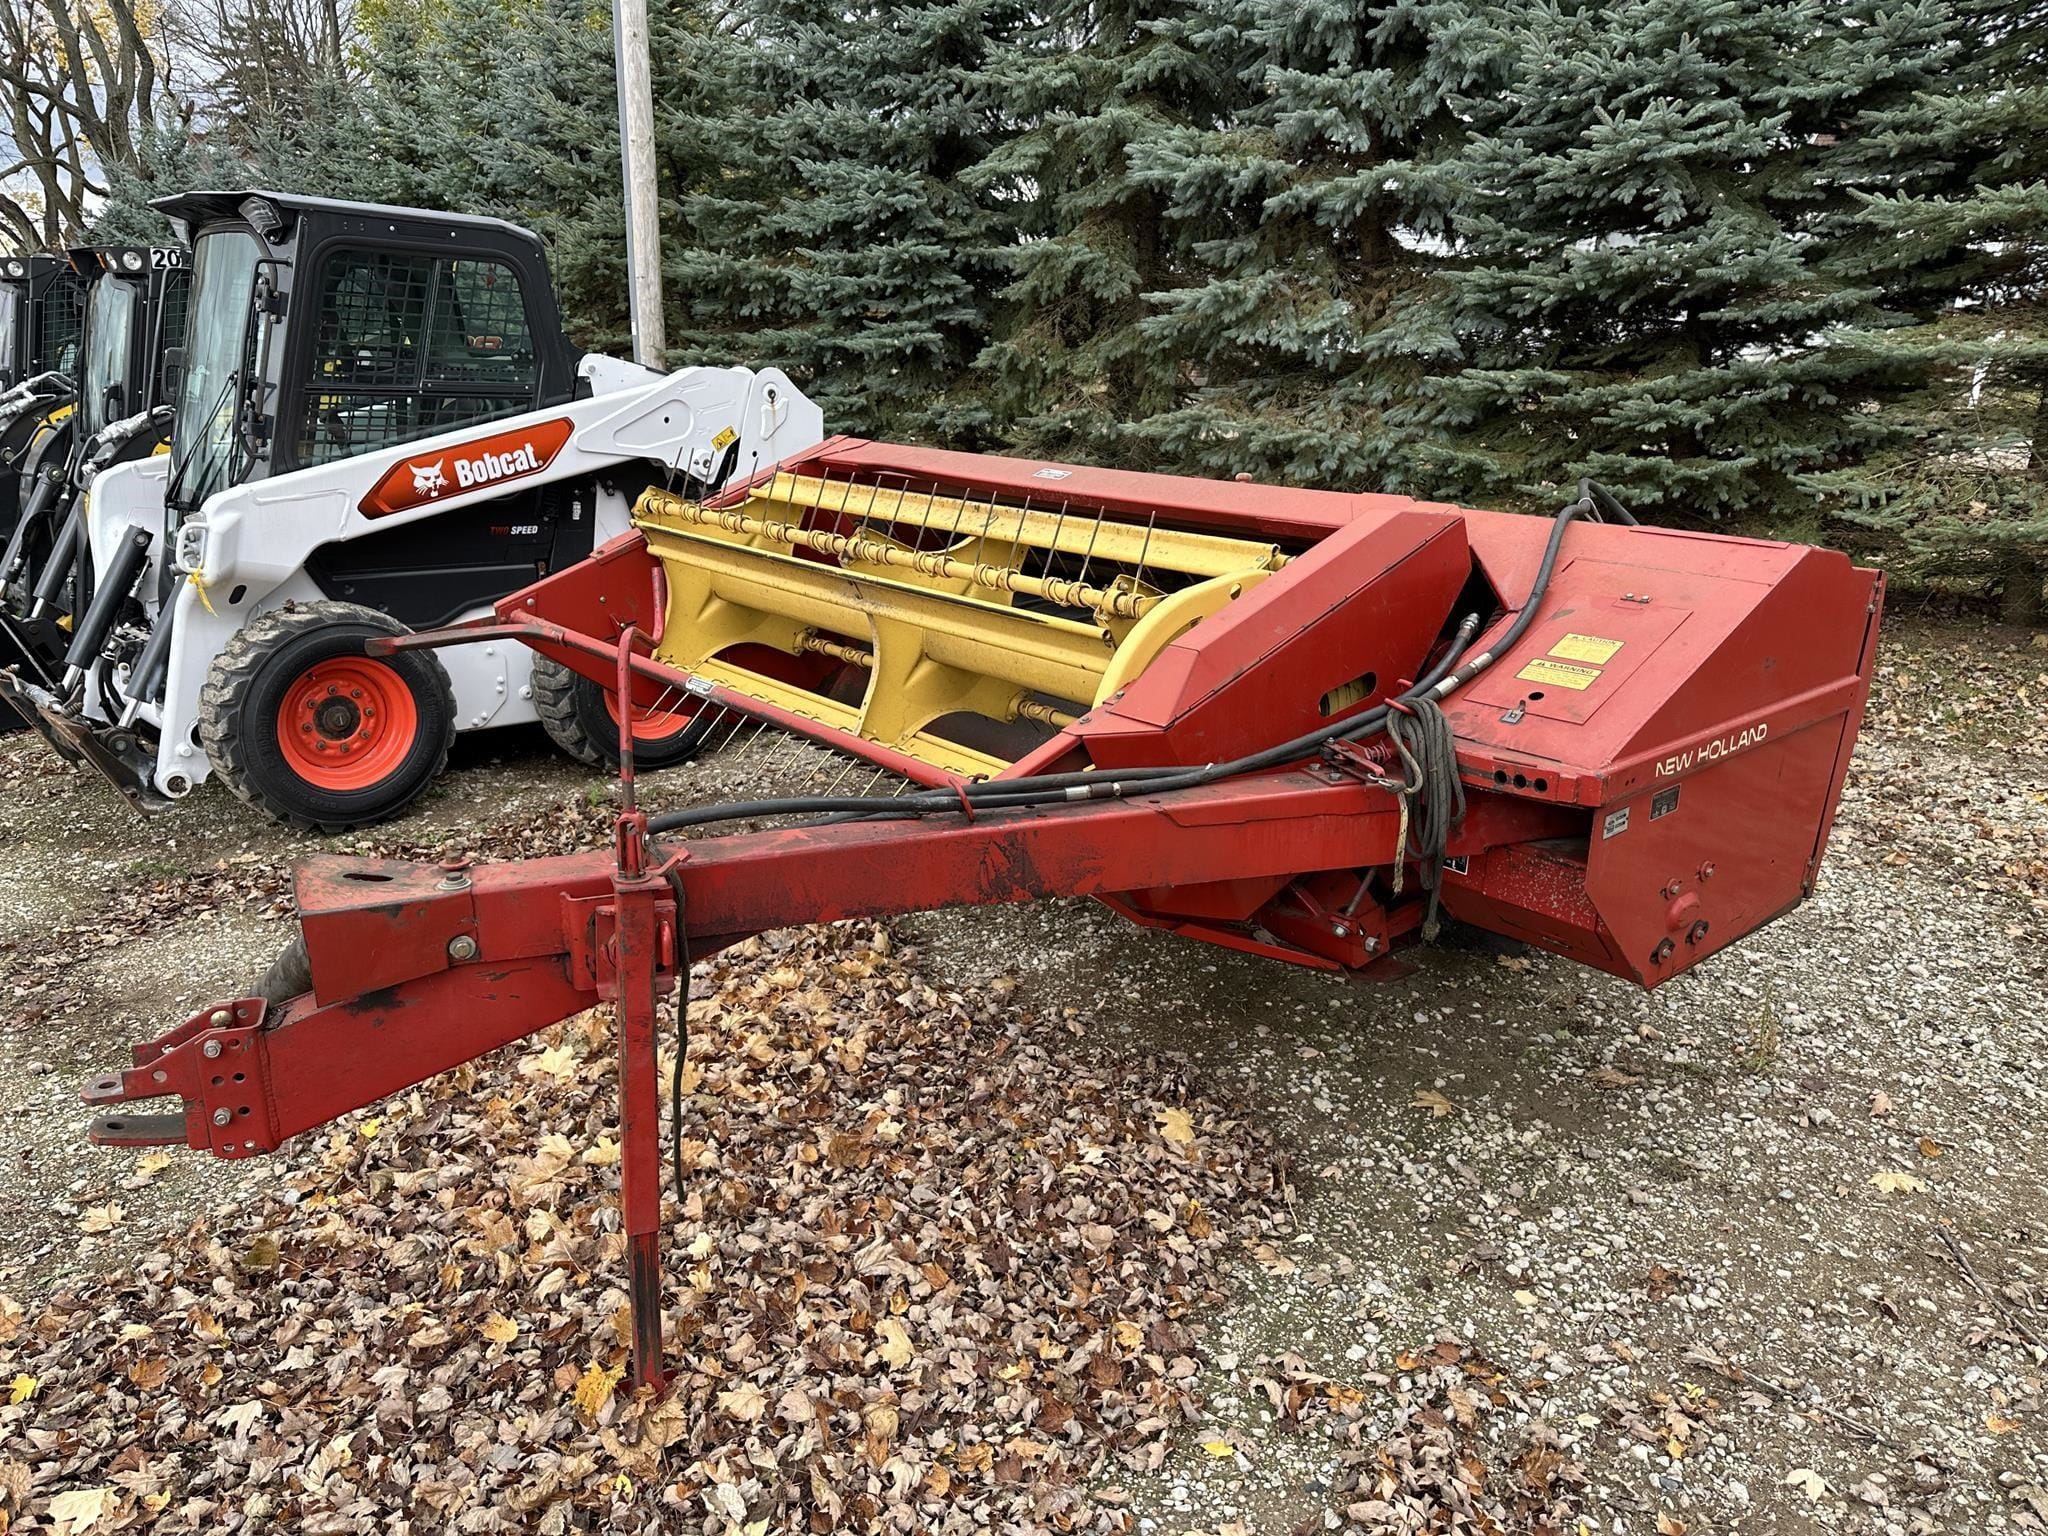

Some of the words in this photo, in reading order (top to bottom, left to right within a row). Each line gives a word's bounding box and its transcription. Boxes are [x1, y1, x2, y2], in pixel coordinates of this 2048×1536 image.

[152, 249, 180, 267] 20
[454, 442, 539, 487] Bobcat
[490, 526, 510, 535] TWO
[510, 525, 538, 534] SPEED
[1549, 663, 1594, 675] WARNING
[1655, 751, 1693, 777] NEW
[1697, 723, 1767, 762] HOLLAND
